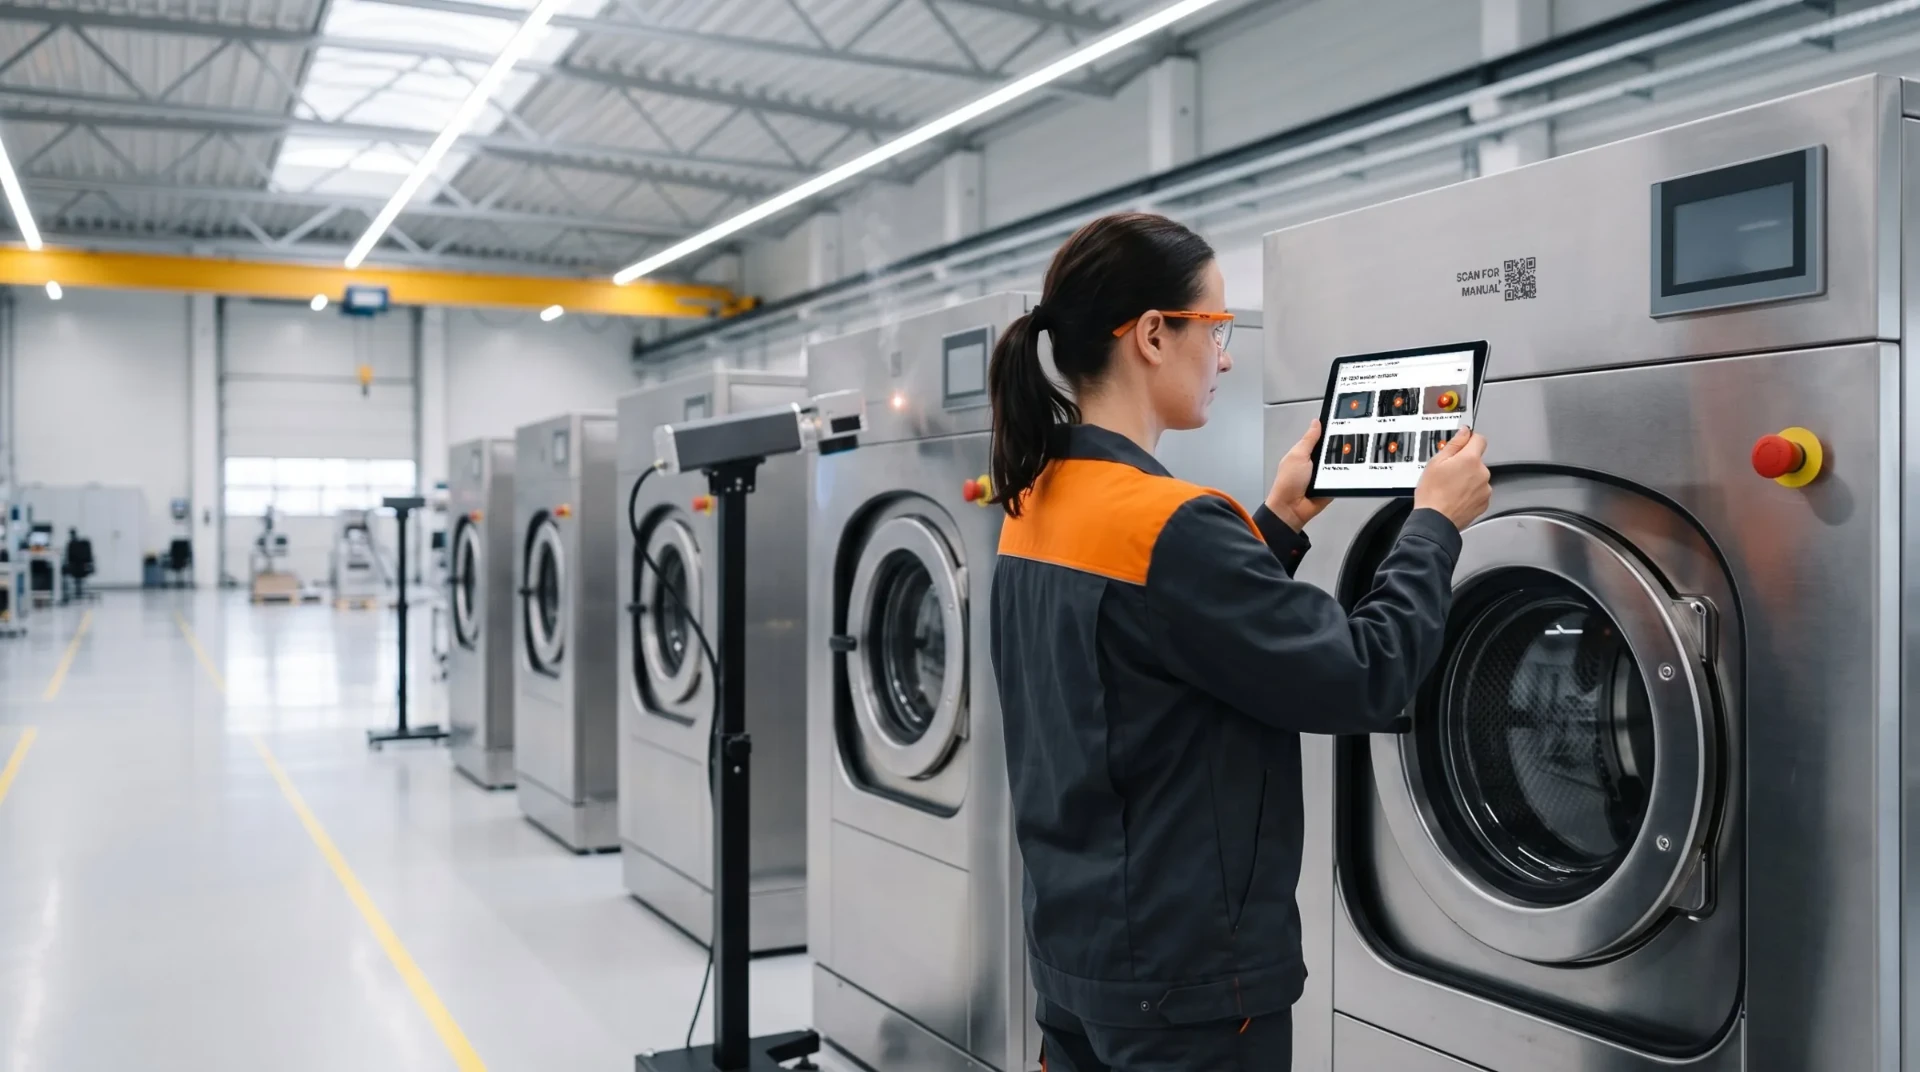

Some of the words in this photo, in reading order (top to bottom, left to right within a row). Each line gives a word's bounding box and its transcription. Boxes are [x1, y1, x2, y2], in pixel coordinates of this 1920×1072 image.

[1456, 270, 1480, 282] SCAN
[1482, 267, 1500, 279] FOR
[1462, 283, 1500, 297] MANUAL
